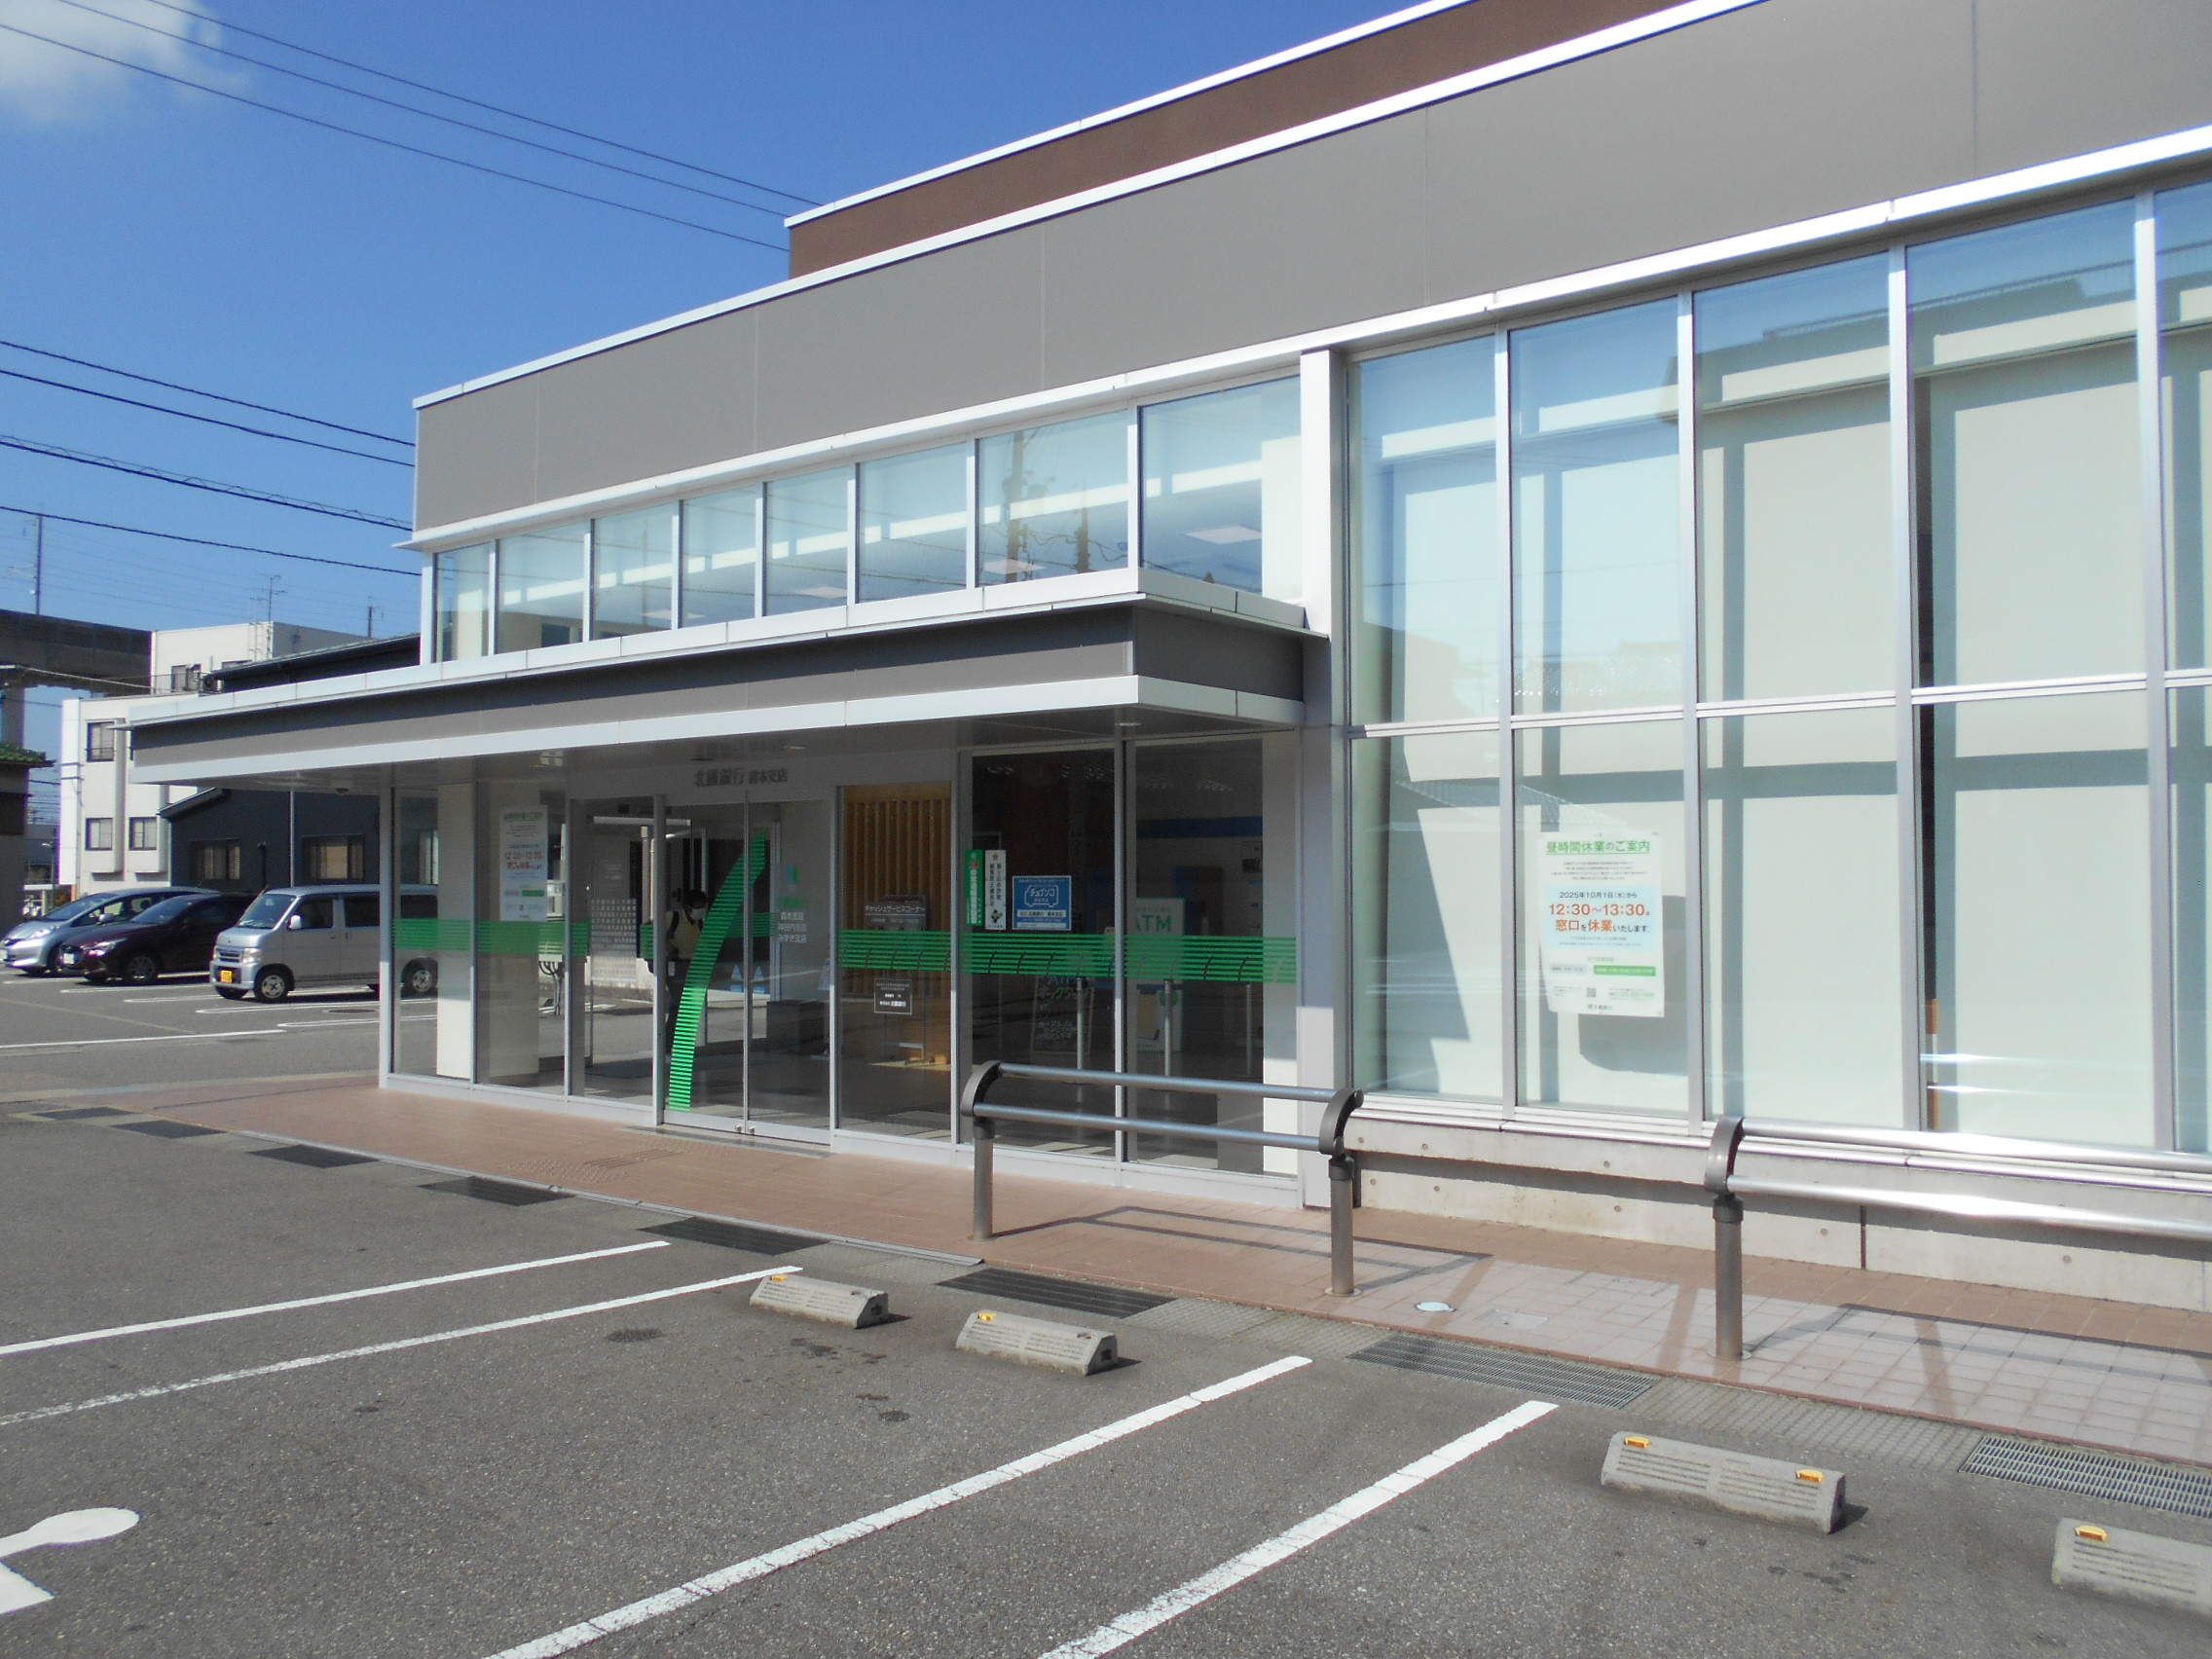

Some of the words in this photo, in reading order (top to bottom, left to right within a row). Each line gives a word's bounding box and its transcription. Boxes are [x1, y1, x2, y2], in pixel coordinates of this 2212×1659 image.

[1547, 840, 1650, 853] 昼時間休業のご案内
[1030, 888, 1055, 897] チョイソコ
